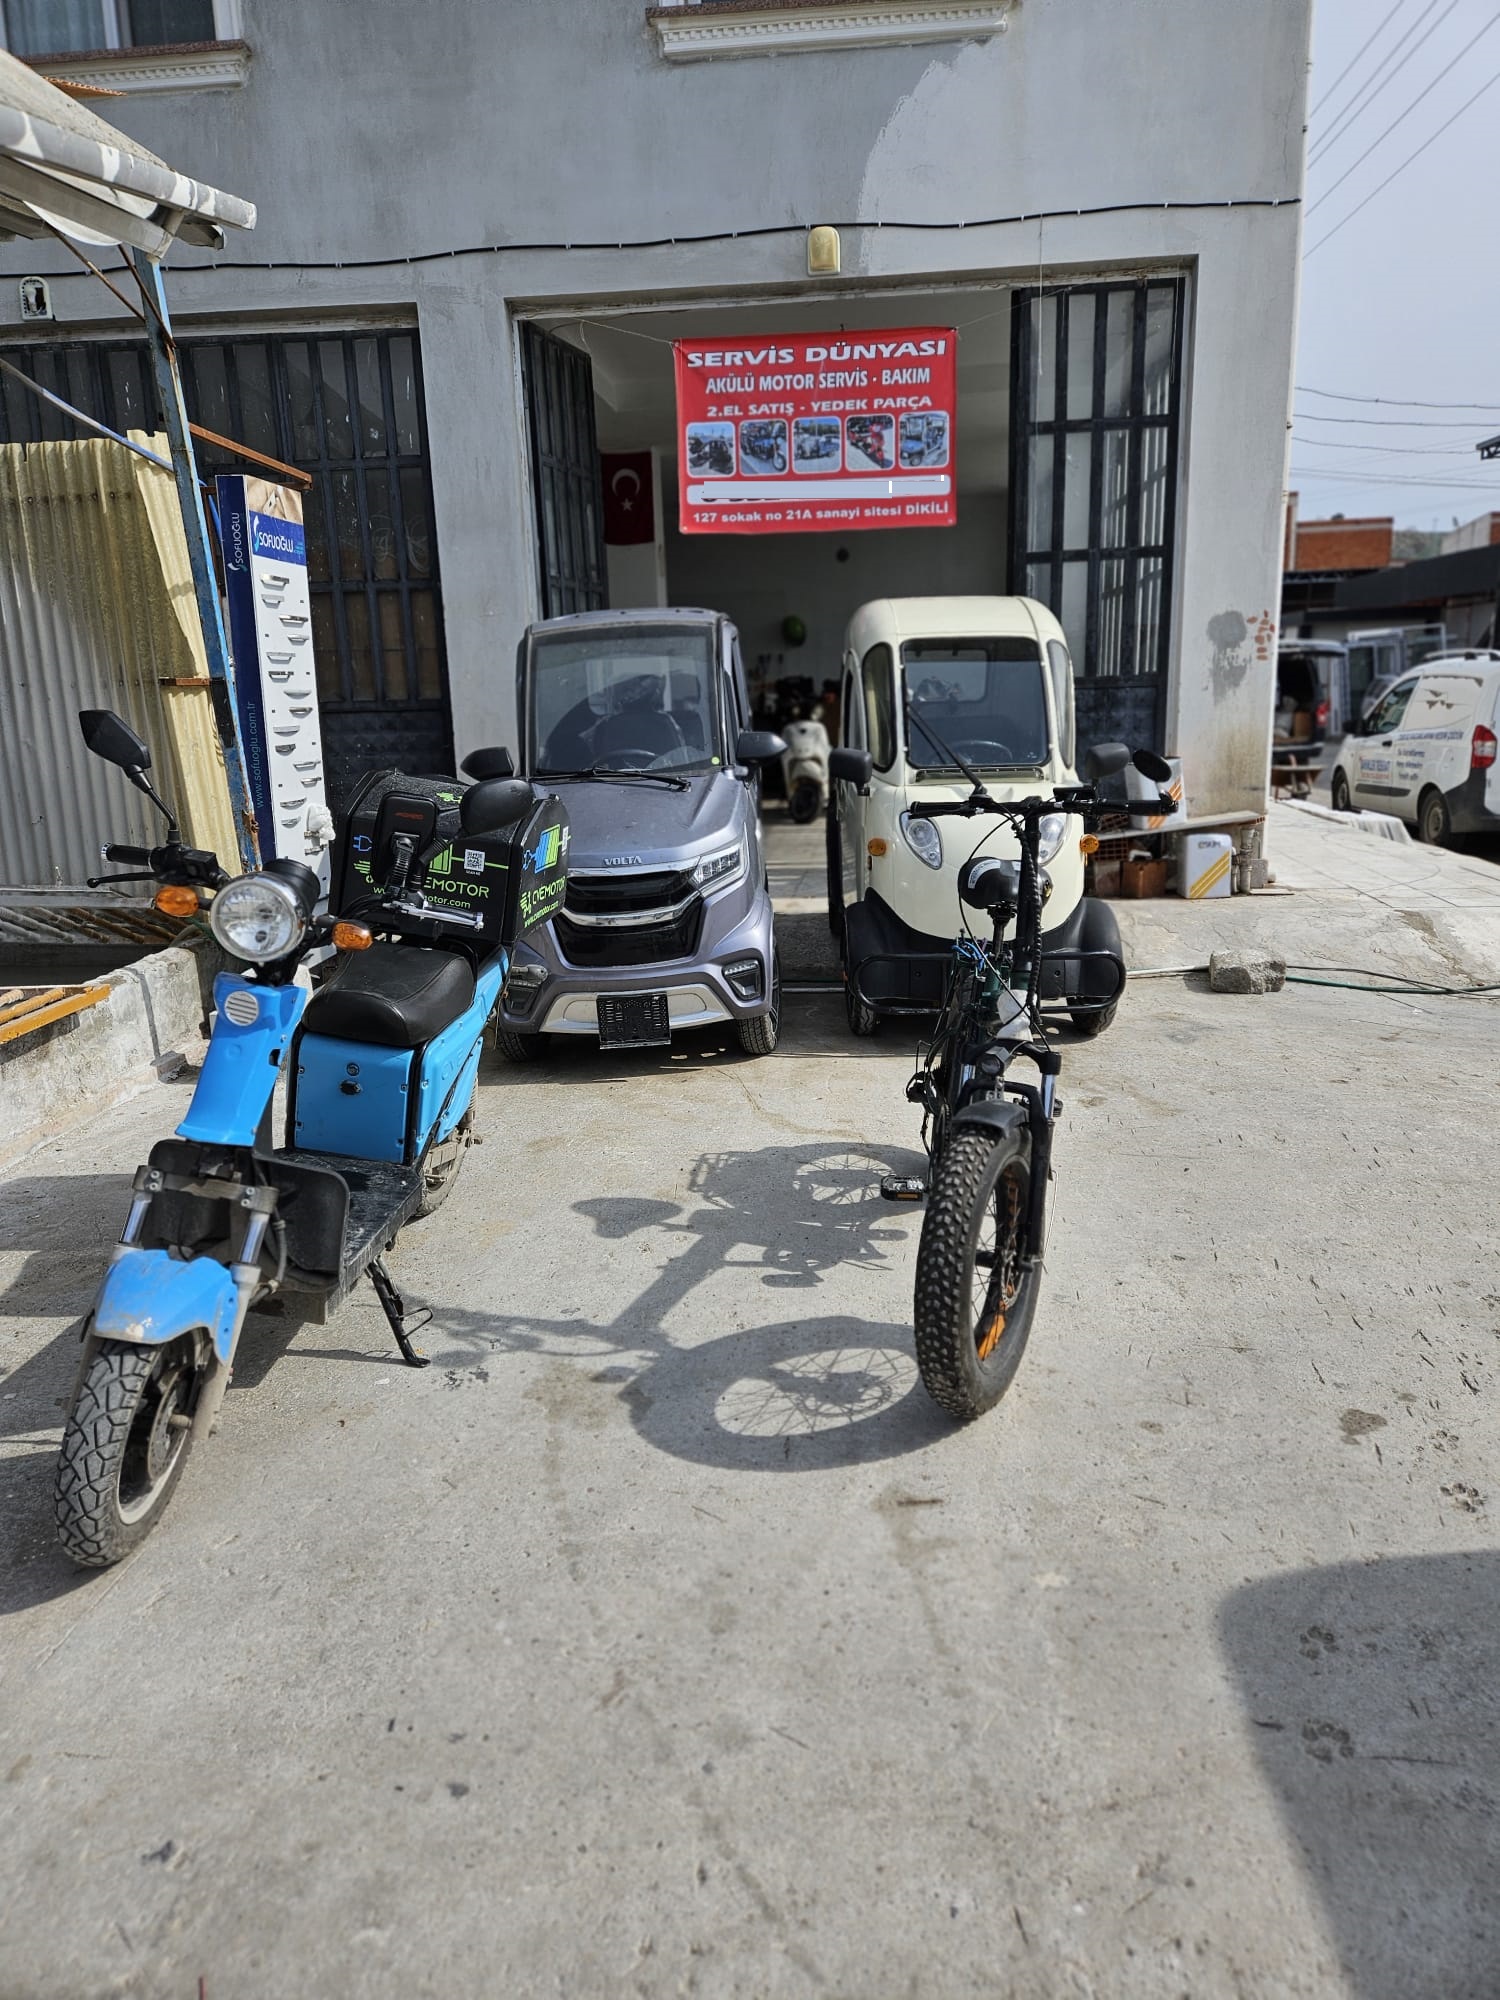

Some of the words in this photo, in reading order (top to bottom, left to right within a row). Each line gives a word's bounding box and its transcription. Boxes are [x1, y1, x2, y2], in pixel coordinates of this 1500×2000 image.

[687, 345, 794, 368] SERVİS
[805, 339, 946, 363] DÜNYASI
[705, 371, 755, 394] AKÜLÜ
[759, 373, 815, 391] MOTOR
[819, 366, 868, 389] SERVİS
[881, 367, 931, 385] BAKIM
[707, 405, 744, 417] 2.EL
[748, 402, 795, 416] SATIŞ
[810, 399, 868, 412] YEDEK
[873, 396, 933, 410] PARÇA
[693, 512, 718, 523] 127
[721, 511, 762, 522] sokak
[765, 511, 783, 520] no
[786, 508, 813, 520] 21A
[815, 507, 860, 520] sanayi
[864, 505, 902, 516] sitesi
[905, 501, 949, 515] DİKİLİ
[246, 702, 265, 809] www.sofuoglu.com.tr
[603, 855, 643, 867] VOLTA
